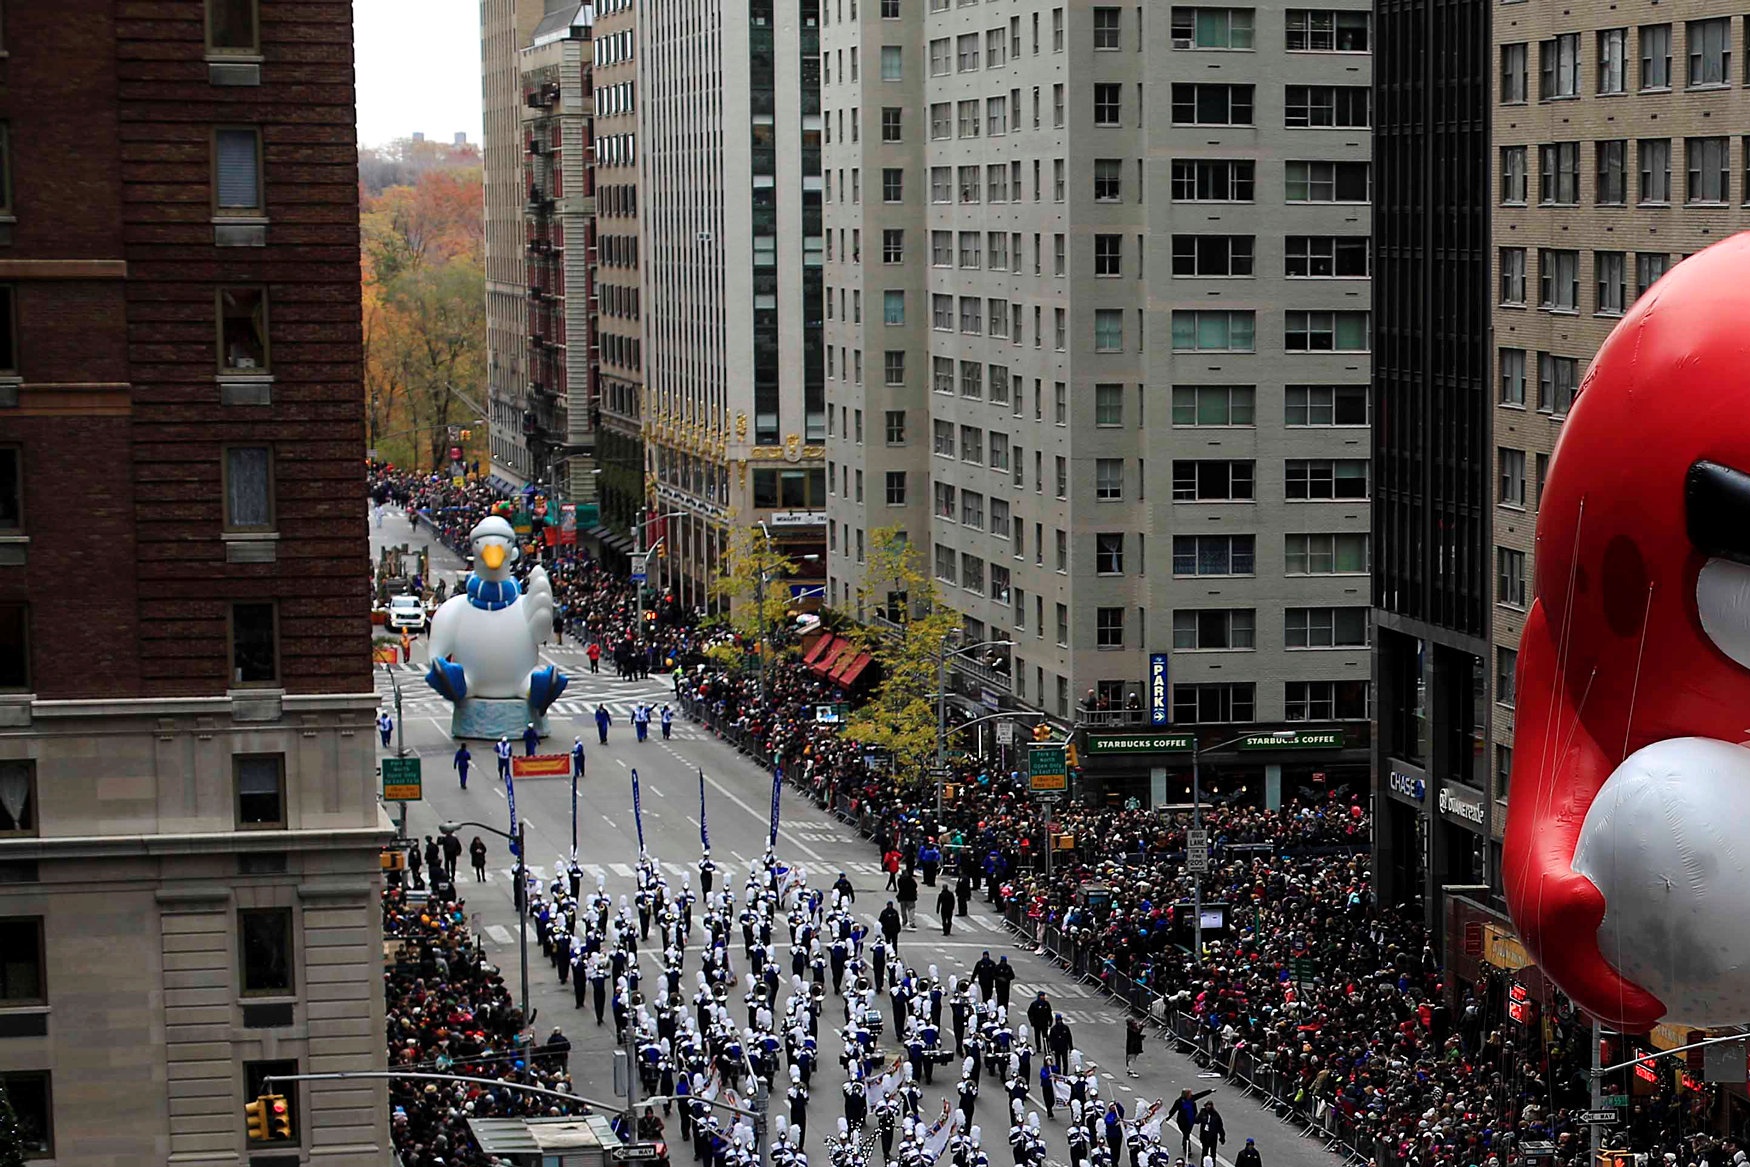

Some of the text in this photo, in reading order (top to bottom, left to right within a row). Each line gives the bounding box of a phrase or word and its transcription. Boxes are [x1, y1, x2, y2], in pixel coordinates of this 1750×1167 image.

[1153, 664, 1165, 708] PARK
[1097, 739, 1186, 748] STARBUCKS COFFEE
[1246, 735, 1335, 745] STARBUS COFFEE
[1390, 771, 1416, 799] CHASE
